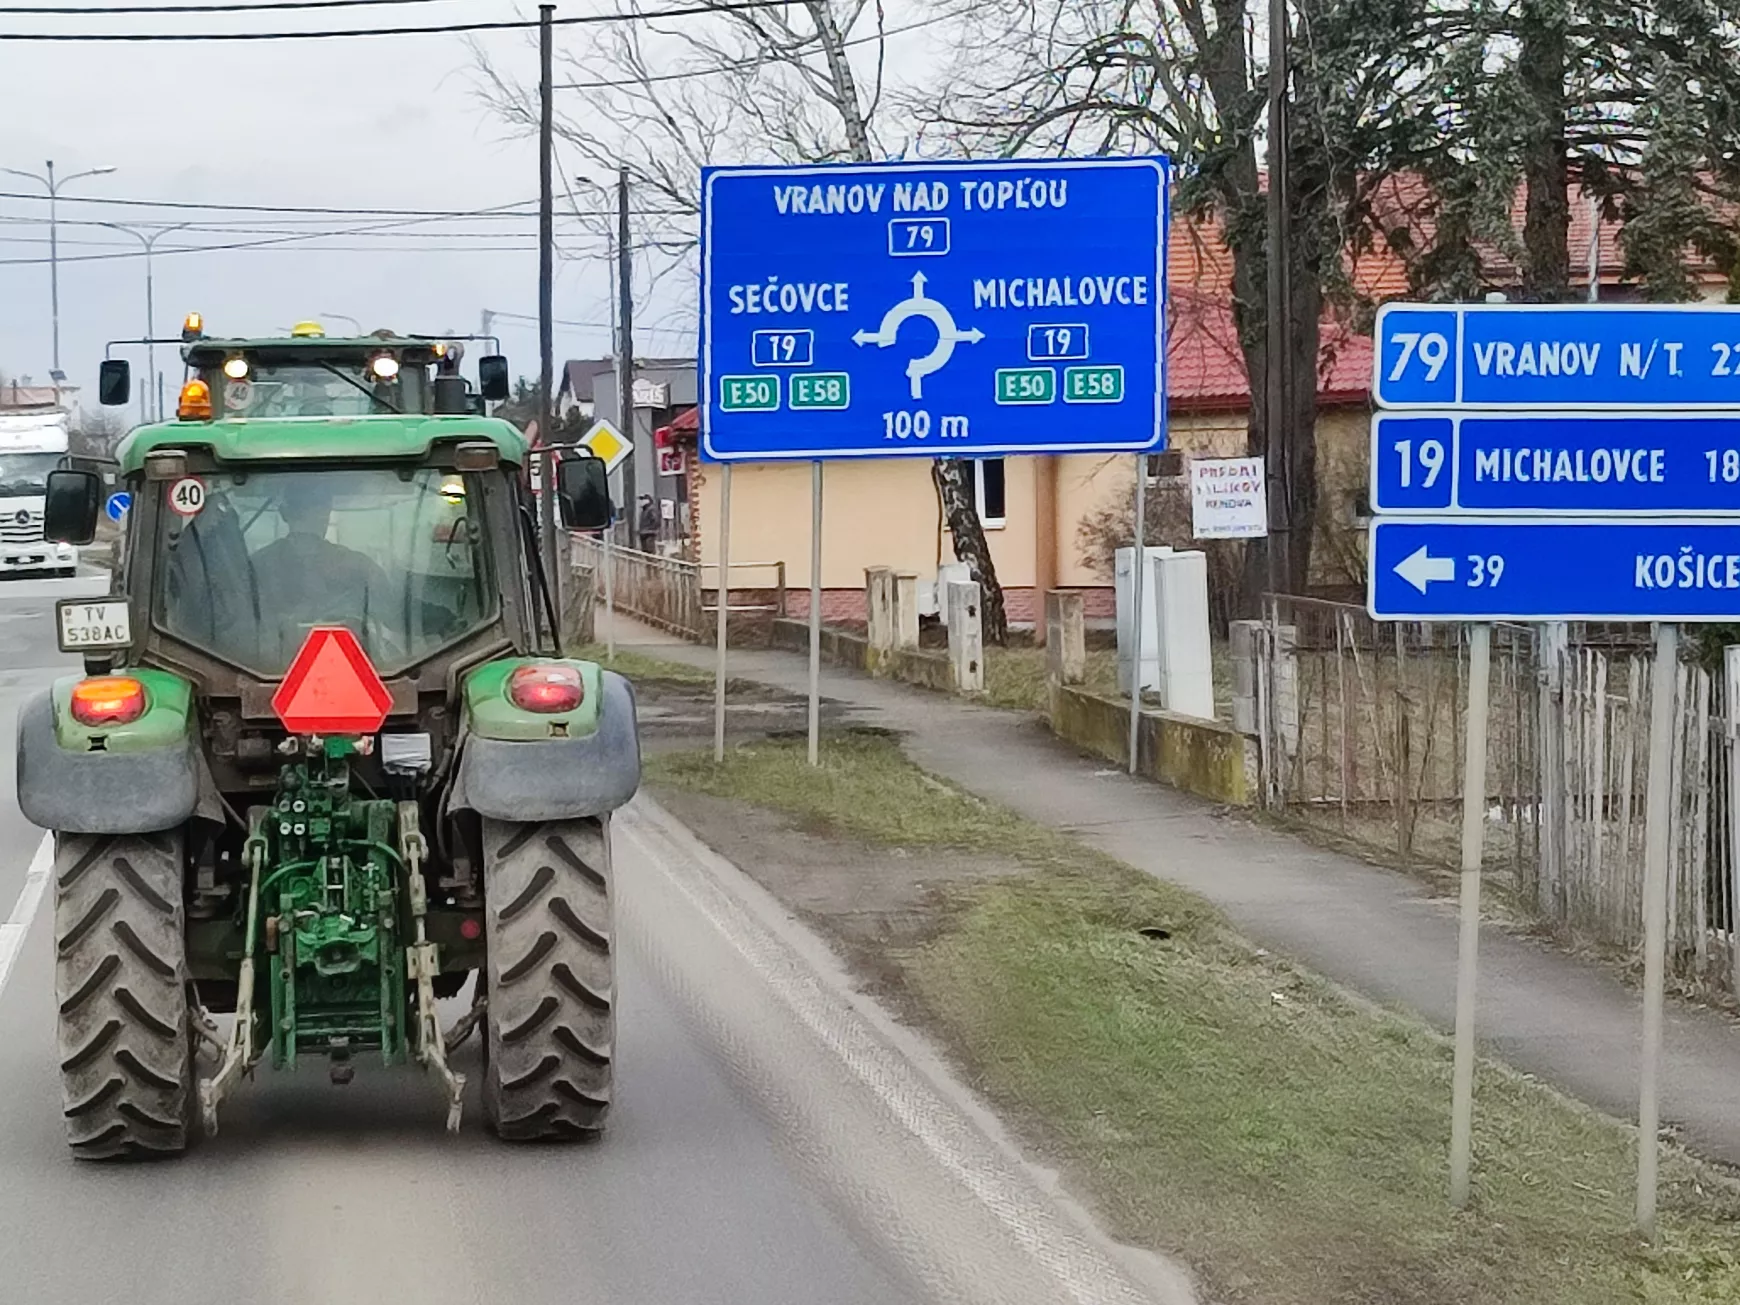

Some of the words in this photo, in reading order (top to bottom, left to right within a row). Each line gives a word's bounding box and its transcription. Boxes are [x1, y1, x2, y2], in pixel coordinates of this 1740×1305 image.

[774, 184, 885, 214] VRANOV
[893, 181, 949, 212] NAD
[960, 177, 1067, 210] TOPĽOU
[906, 225, 933, 248] 79
[729, 276, 849, 314] SEČOVCE
[974, 276, 1147, 308] MICHALOVCE
[769, 335, 796, 361] 19
[1044, 328, 1071, 355] 19
[1388, 332, 1449, 382] 79
[1473, 342, 1601, 377] VRANOV
[731, 382, 770, 404] E50
[798, 380, 841, 402] E58
[1006, 375, 1045, 397] E50
[1074, 373, 1114, 395] E58
[882, 410, 931, 440] 100
[940, 416, 969, 438] m
[1394, 439, 1445, 488] 19
[1475, 448, 1665, 483] MICHALOVCE
[1704, 449, 1740, 482] 18
[176, 485, 201, 505] 40
[1466, 555, 1505, 588] 39
[1634, 544, 1740, 589] KOŠICE
[84, 606, 106, 623] TV
